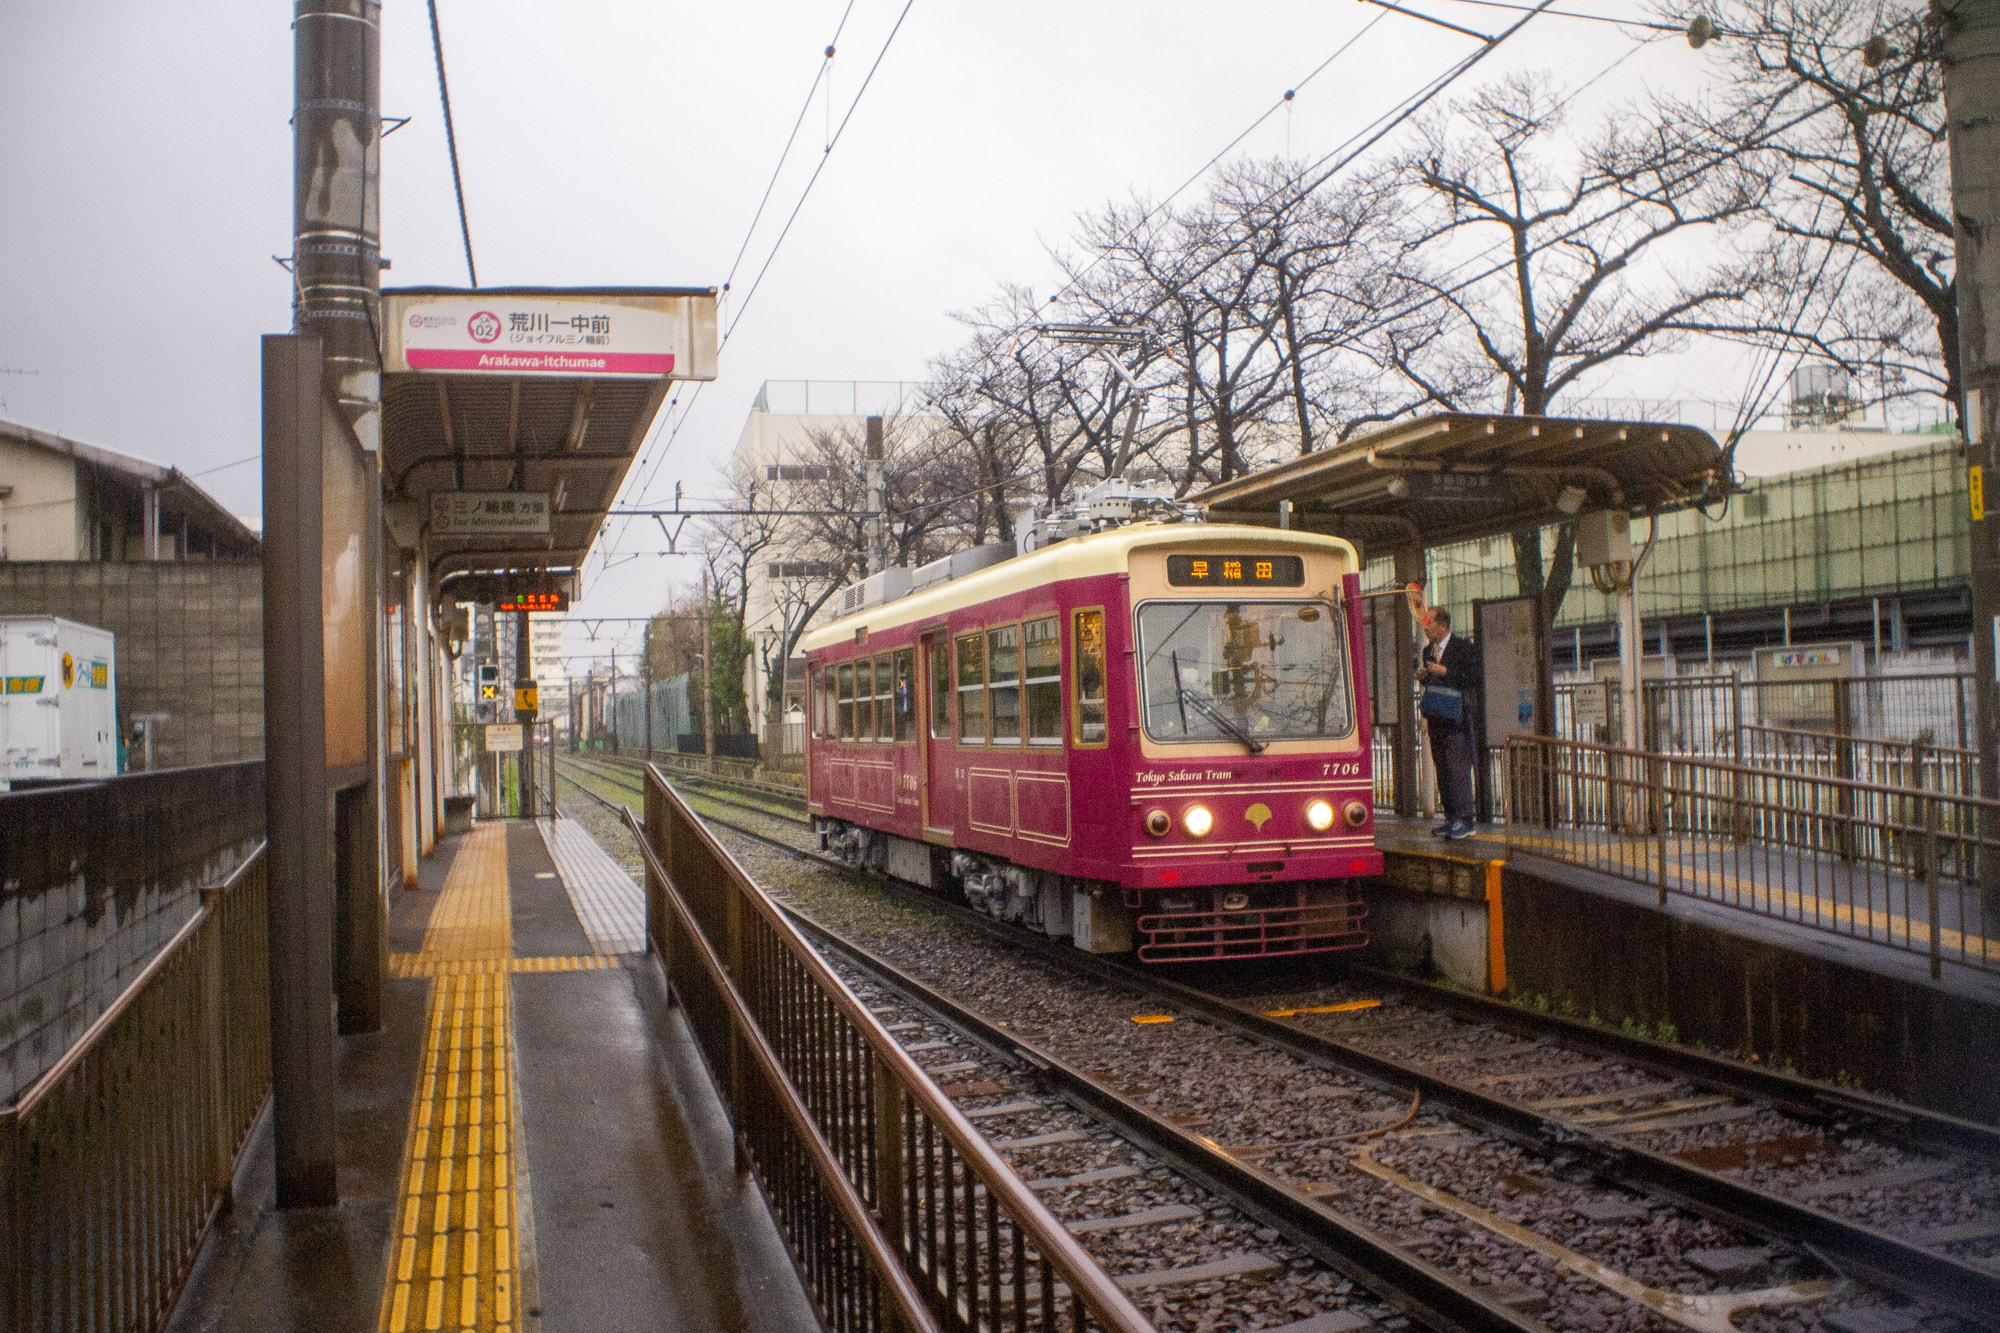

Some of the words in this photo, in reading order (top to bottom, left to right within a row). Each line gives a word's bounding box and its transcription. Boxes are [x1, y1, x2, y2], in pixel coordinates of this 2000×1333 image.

[475, 325, 493, 337] 02
[509, 312, 610, 334] 荒川一中前
[478, 353, 606, 369] Arakawa-itchumae
[1191, 560, 1273, 579] 早稲田
[1135, 771, 1166, 786] Tokyo
[1167, 770, 1202, 782] Sakura
[1205, 769, 1232, 781] Tram
[1322, 763, 1360, 776] 7706
